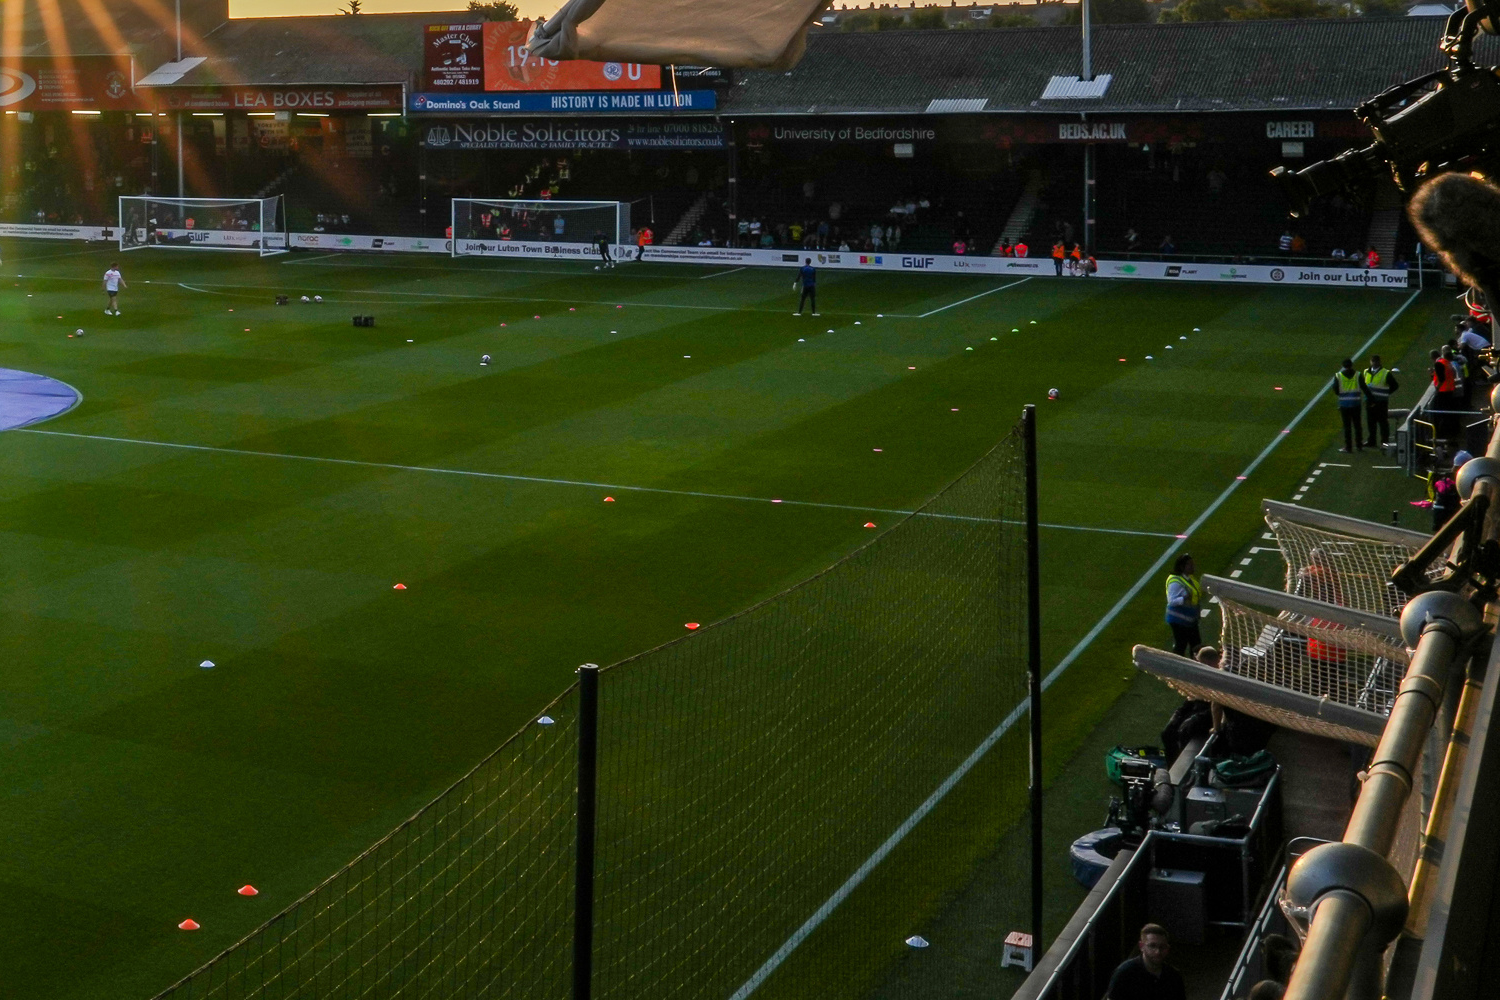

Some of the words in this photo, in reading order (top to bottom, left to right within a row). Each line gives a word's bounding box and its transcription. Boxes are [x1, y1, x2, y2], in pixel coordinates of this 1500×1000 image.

[432, 33, 458, 48] Master
[459, 33, 478, 48] Chef
[507, 45, 560, 67] 19.1
[234, 92, 267, 107] LEA
[273, 91, 335, 107] BOXES
[426, 100, 466, 109] Domino's
[469, 100, 490, 109] Oak
[493, 99, 520, 109] Stand
[551, 95, 594, 109] HISTORY
[598, 95, 608, 108] IS
[611, 95, 640, 108] MADE
[643, 95, 654, 108] IN
[657, 94, 692, 107] LUTON
[453, 123, 518, 142] Noble
[522, 122, 620, 142] Solicitors
[774, 127, 836, 141] University
[838, 126, 851, 140] of
[855, 126, 936, 140] Bedfordshire
[1058, 123, 1127, 140] BEDS.AC.UK
[1266, 121, 1314, 138] CAREER
[627, 135, 723, 147] www.noblesolicitors.co.uk
[522, 245, 541, 253] Town
[902, 257, 934, 268] GWF
[1298, 271, 1320, 281] Join
[1324, 273, 1342, 281] our
[1346, 272, 1377, 282] Luton
